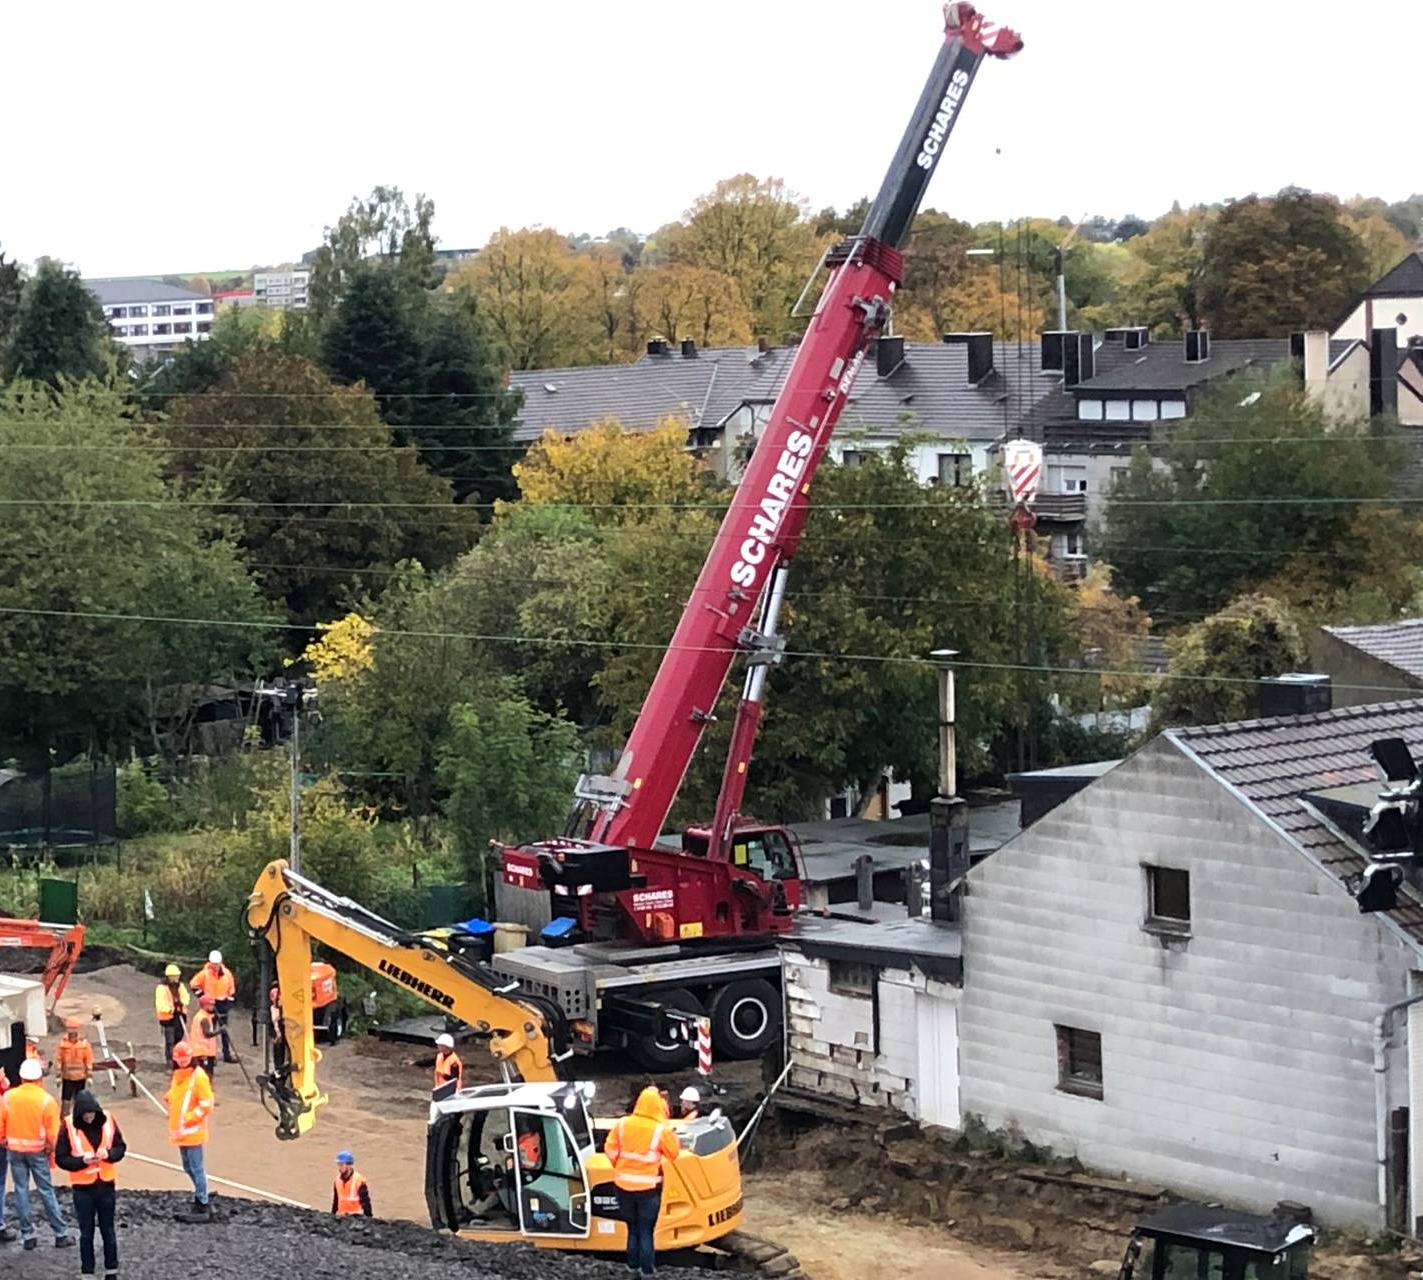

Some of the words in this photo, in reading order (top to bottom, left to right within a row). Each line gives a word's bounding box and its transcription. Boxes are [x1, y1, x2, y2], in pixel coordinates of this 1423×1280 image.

[917, 69, 968, 169] SCHARES
[731, 431, 812, 587] SCHARES
[633, 890, 673, 902] SCHARES
[378, 959, 455, 1010] LIEBHERR
